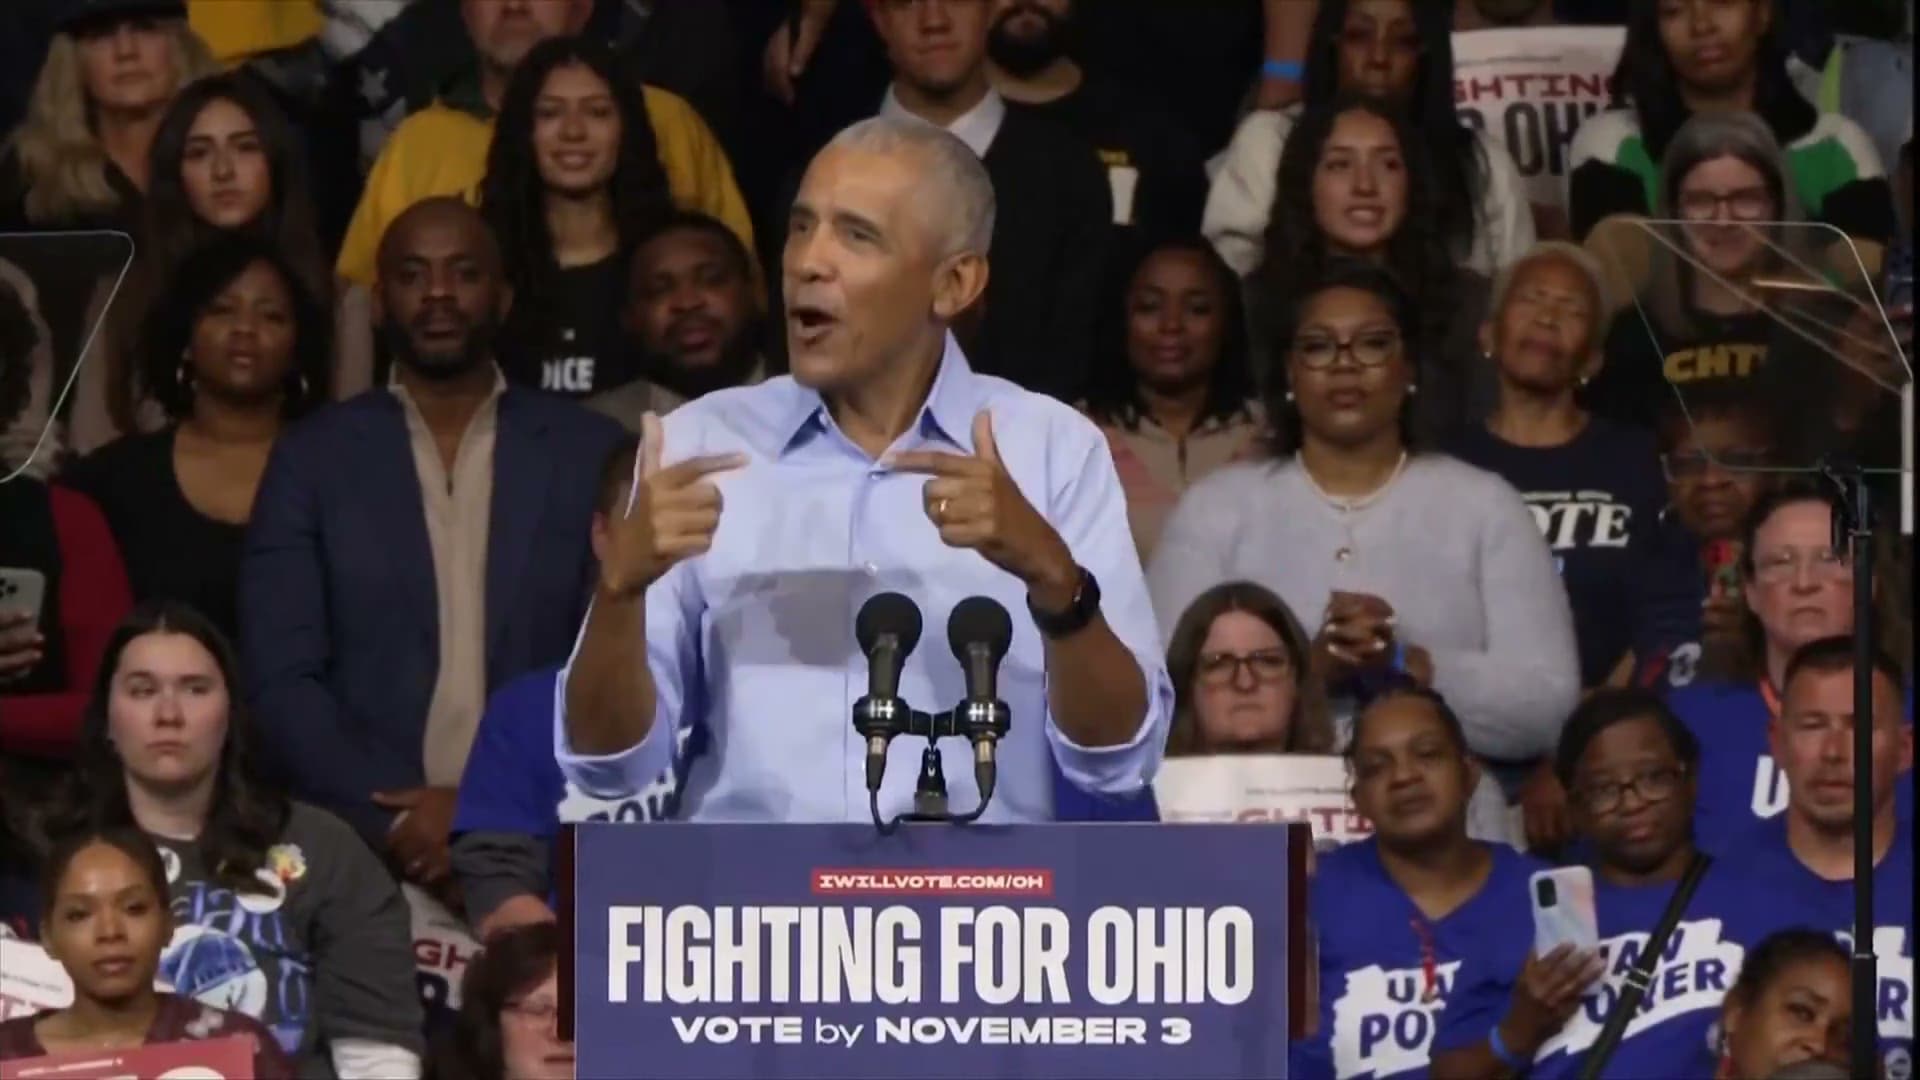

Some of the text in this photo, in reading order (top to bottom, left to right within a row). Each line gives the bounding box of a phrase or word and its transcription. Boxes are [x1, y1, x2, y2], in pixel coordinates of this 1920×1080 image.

[819, 874, 1044, 890] IWILLVOTE.COM/OH
[608, 904, 1254, 1005] FIGHTING FOR OHIO
[671, 1016, 1192, 1048] VOTE by NOVEMBER 3
